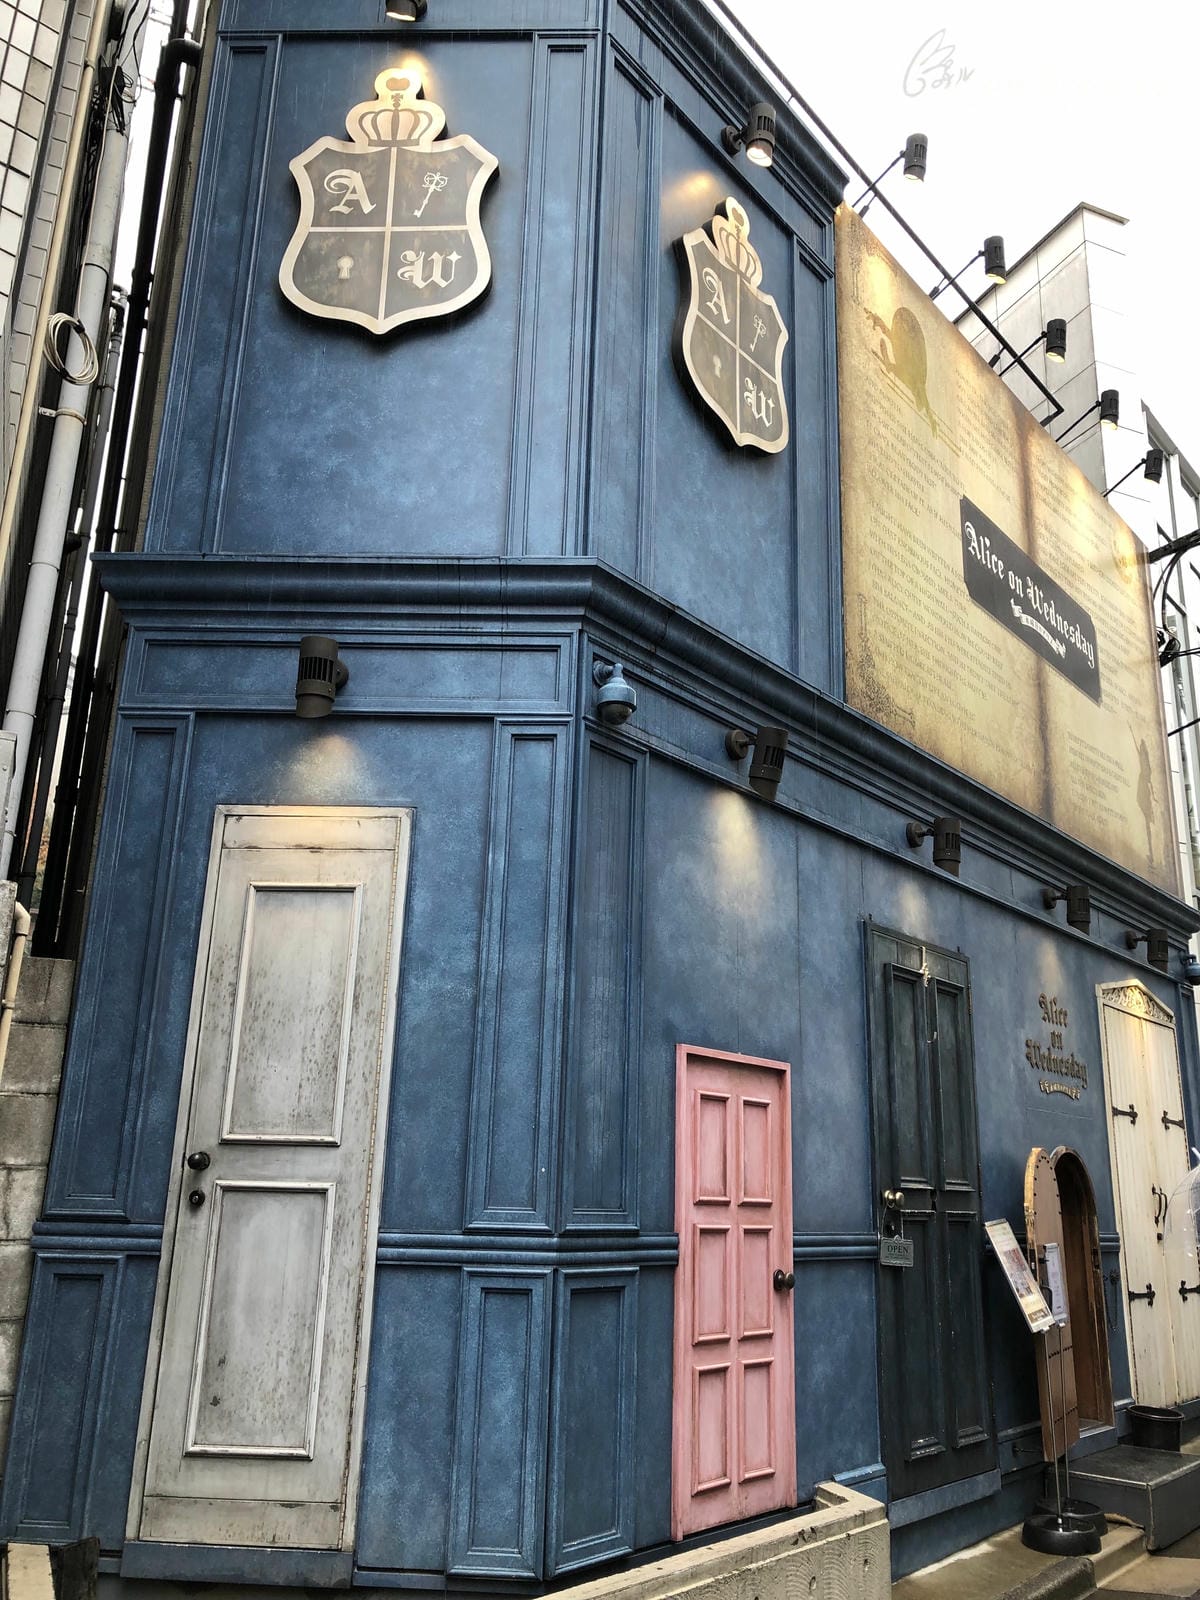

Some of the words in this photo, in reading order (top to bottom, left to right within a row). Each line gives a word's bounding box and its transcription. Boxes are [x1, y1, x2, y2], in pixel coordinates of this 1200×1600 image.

[324, 168, 377, 215] A
[397, 249, 463, 289] W
[702, 267, 731, 325] A
[964, 521, 1005, 580] Alice
[1008, 570, 1024, 597] on
[1027, 576, 1095, 669] Wednesday
[1039, 992, 1068, 1028] Alice
[1050, 1030, 1063, 1051] on
[1025, 1039, 1087, 1090] Wednesday
[887, 1244, 909, 1254] OPEN
